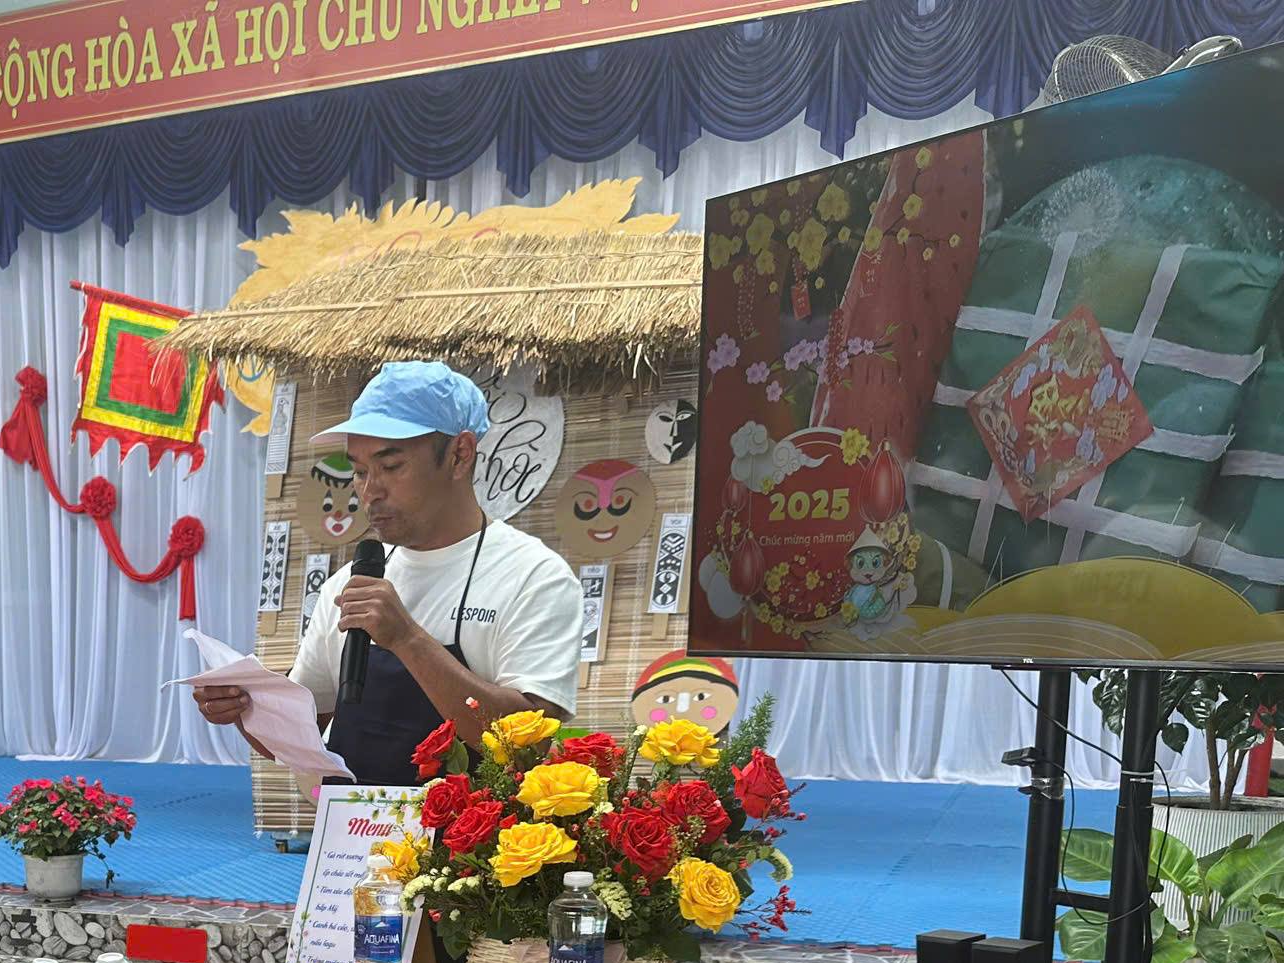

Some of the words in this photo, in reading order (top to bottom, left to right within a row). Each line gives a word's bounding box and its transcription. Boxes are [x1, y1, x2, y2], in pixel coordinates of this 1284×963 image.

[84, 16, 164, 92] HÒA
[170, 3, 226, 78] XÃ
[769, 487, 851, 521] 2025
[450, 607, 497, 624] LESPOIR
[348, 817, 393, 838] Menu
[363, 932, 400, 945] AQUAFINA
